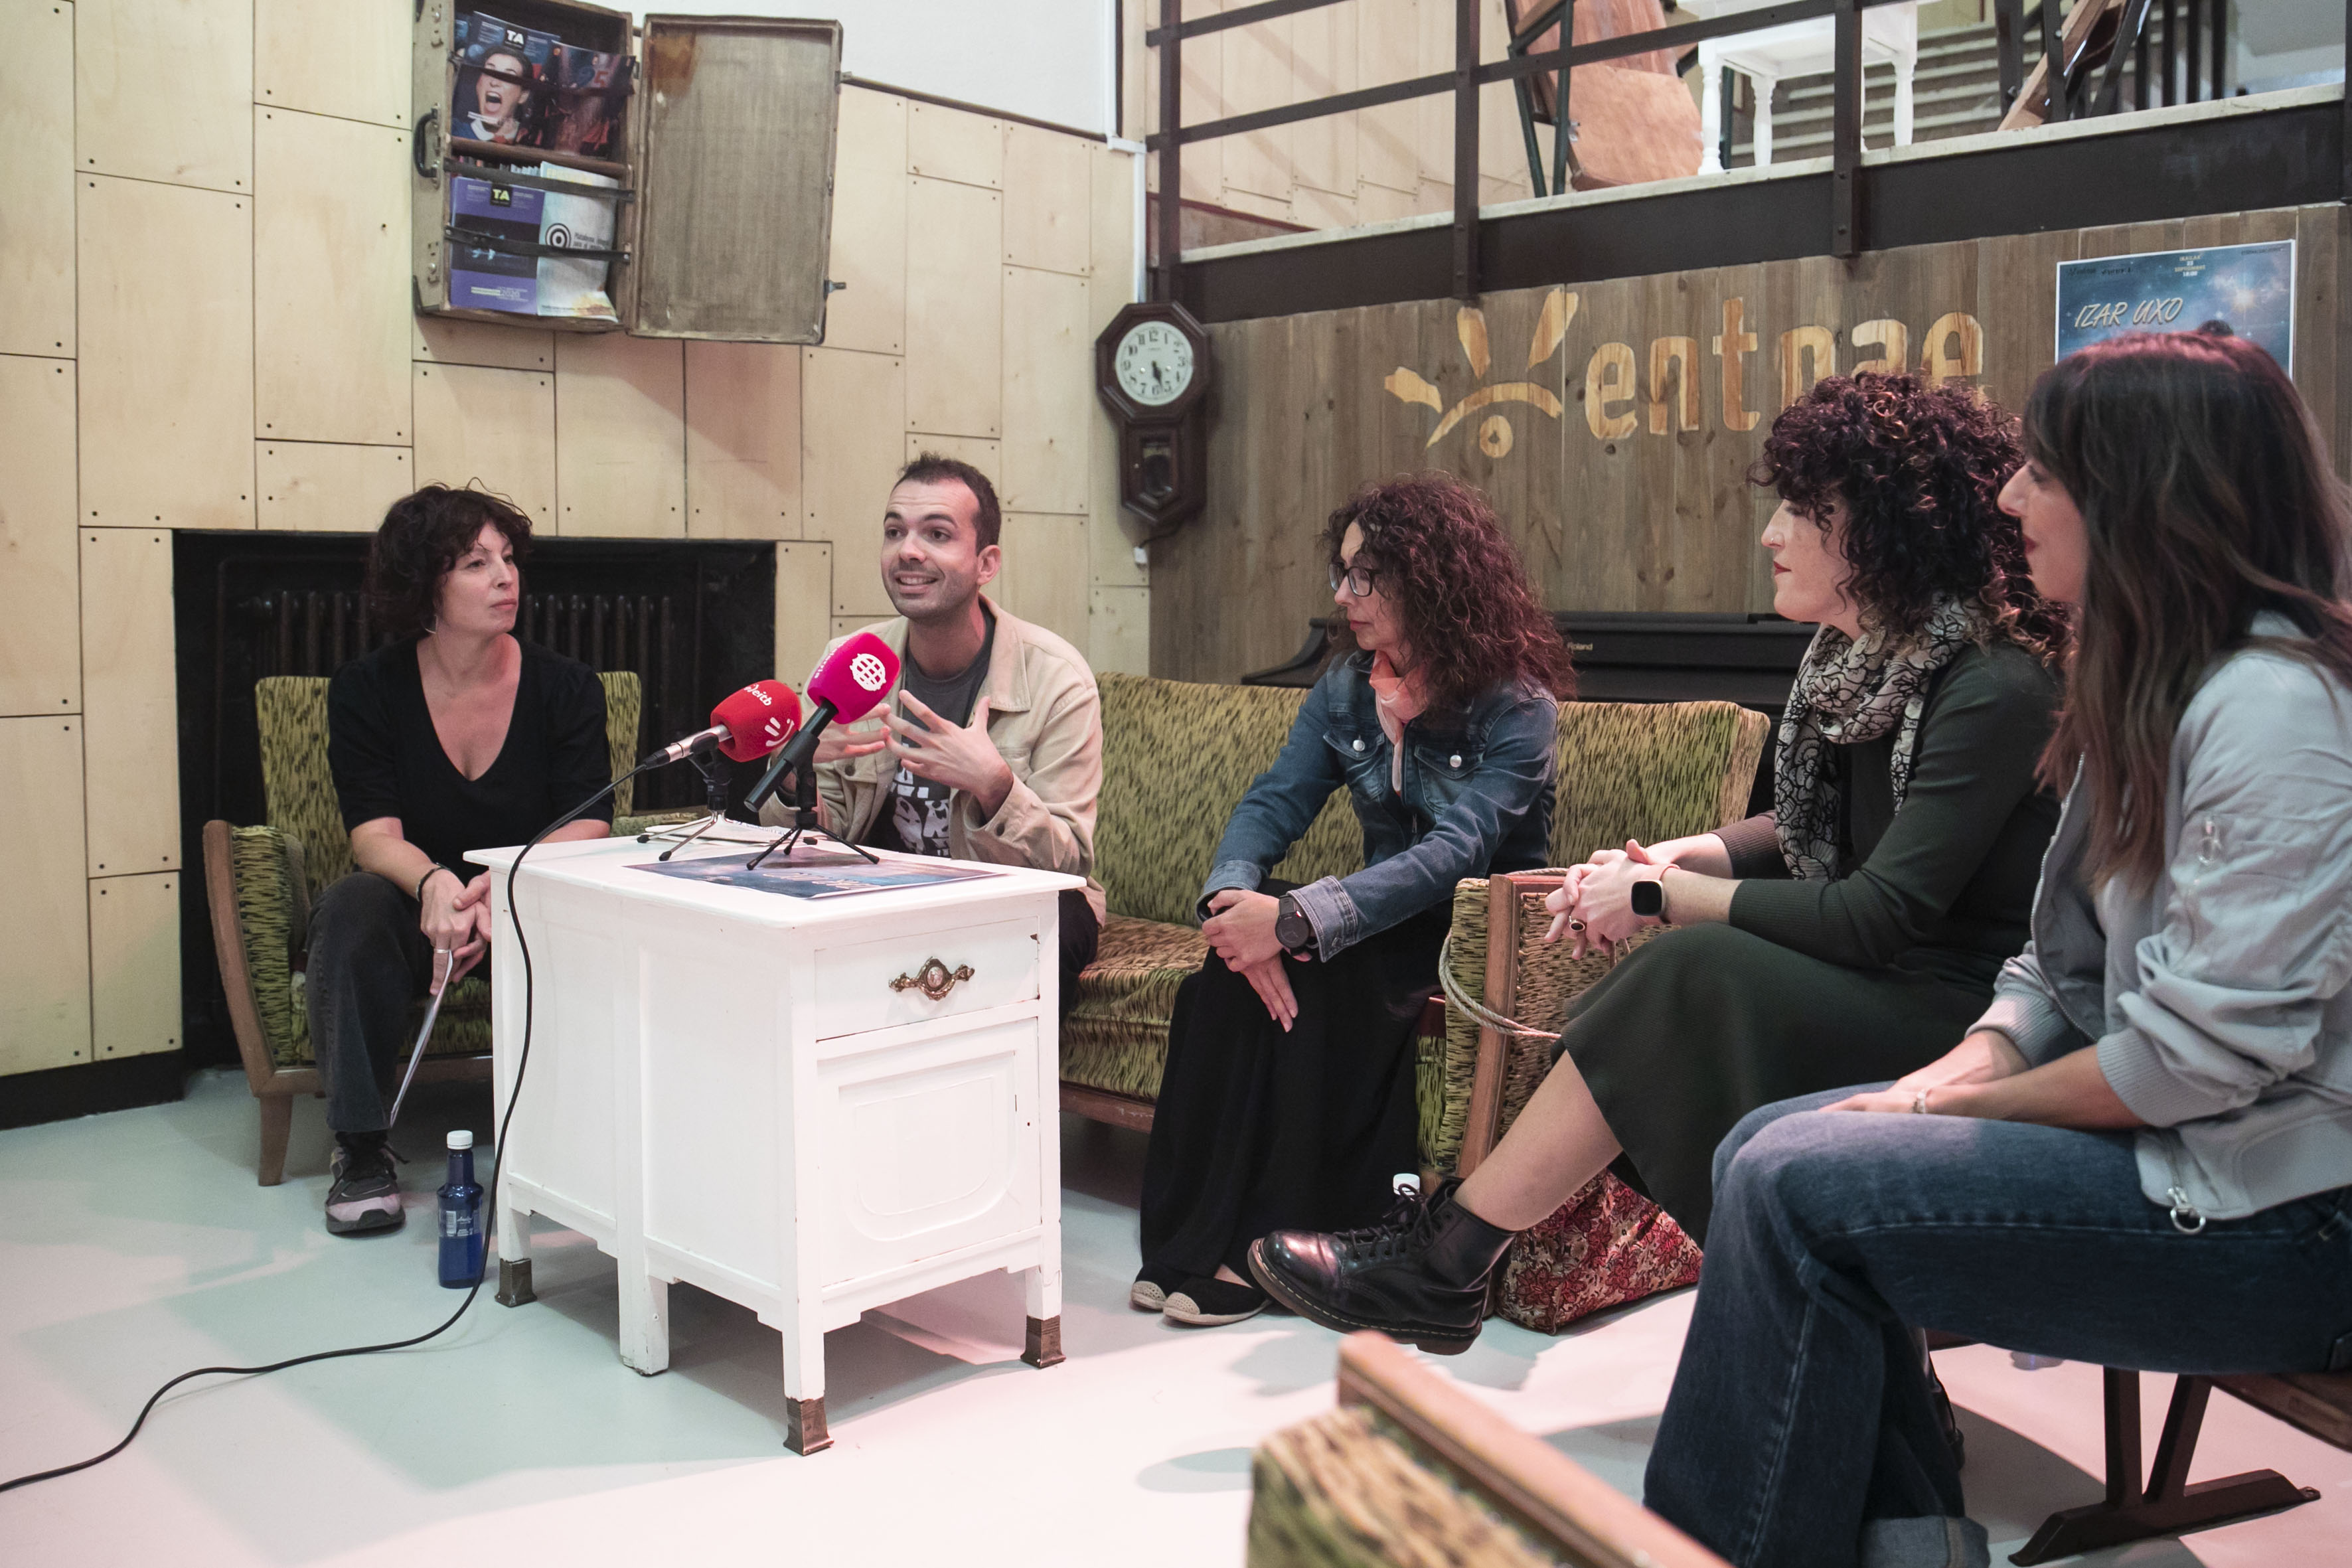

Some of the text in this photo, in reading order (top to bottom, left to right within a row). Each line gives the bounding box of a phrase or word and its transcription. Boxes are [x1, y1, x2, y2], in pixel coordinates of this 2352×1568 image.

[507, 30, 524, 44] TA
[493, 189, 510, 200] TA
[2075, 297, 2183, 329] IZAR UXO
[1149, 329, 1158, 342] 12
[1140, 382, 1147, 394] 7
